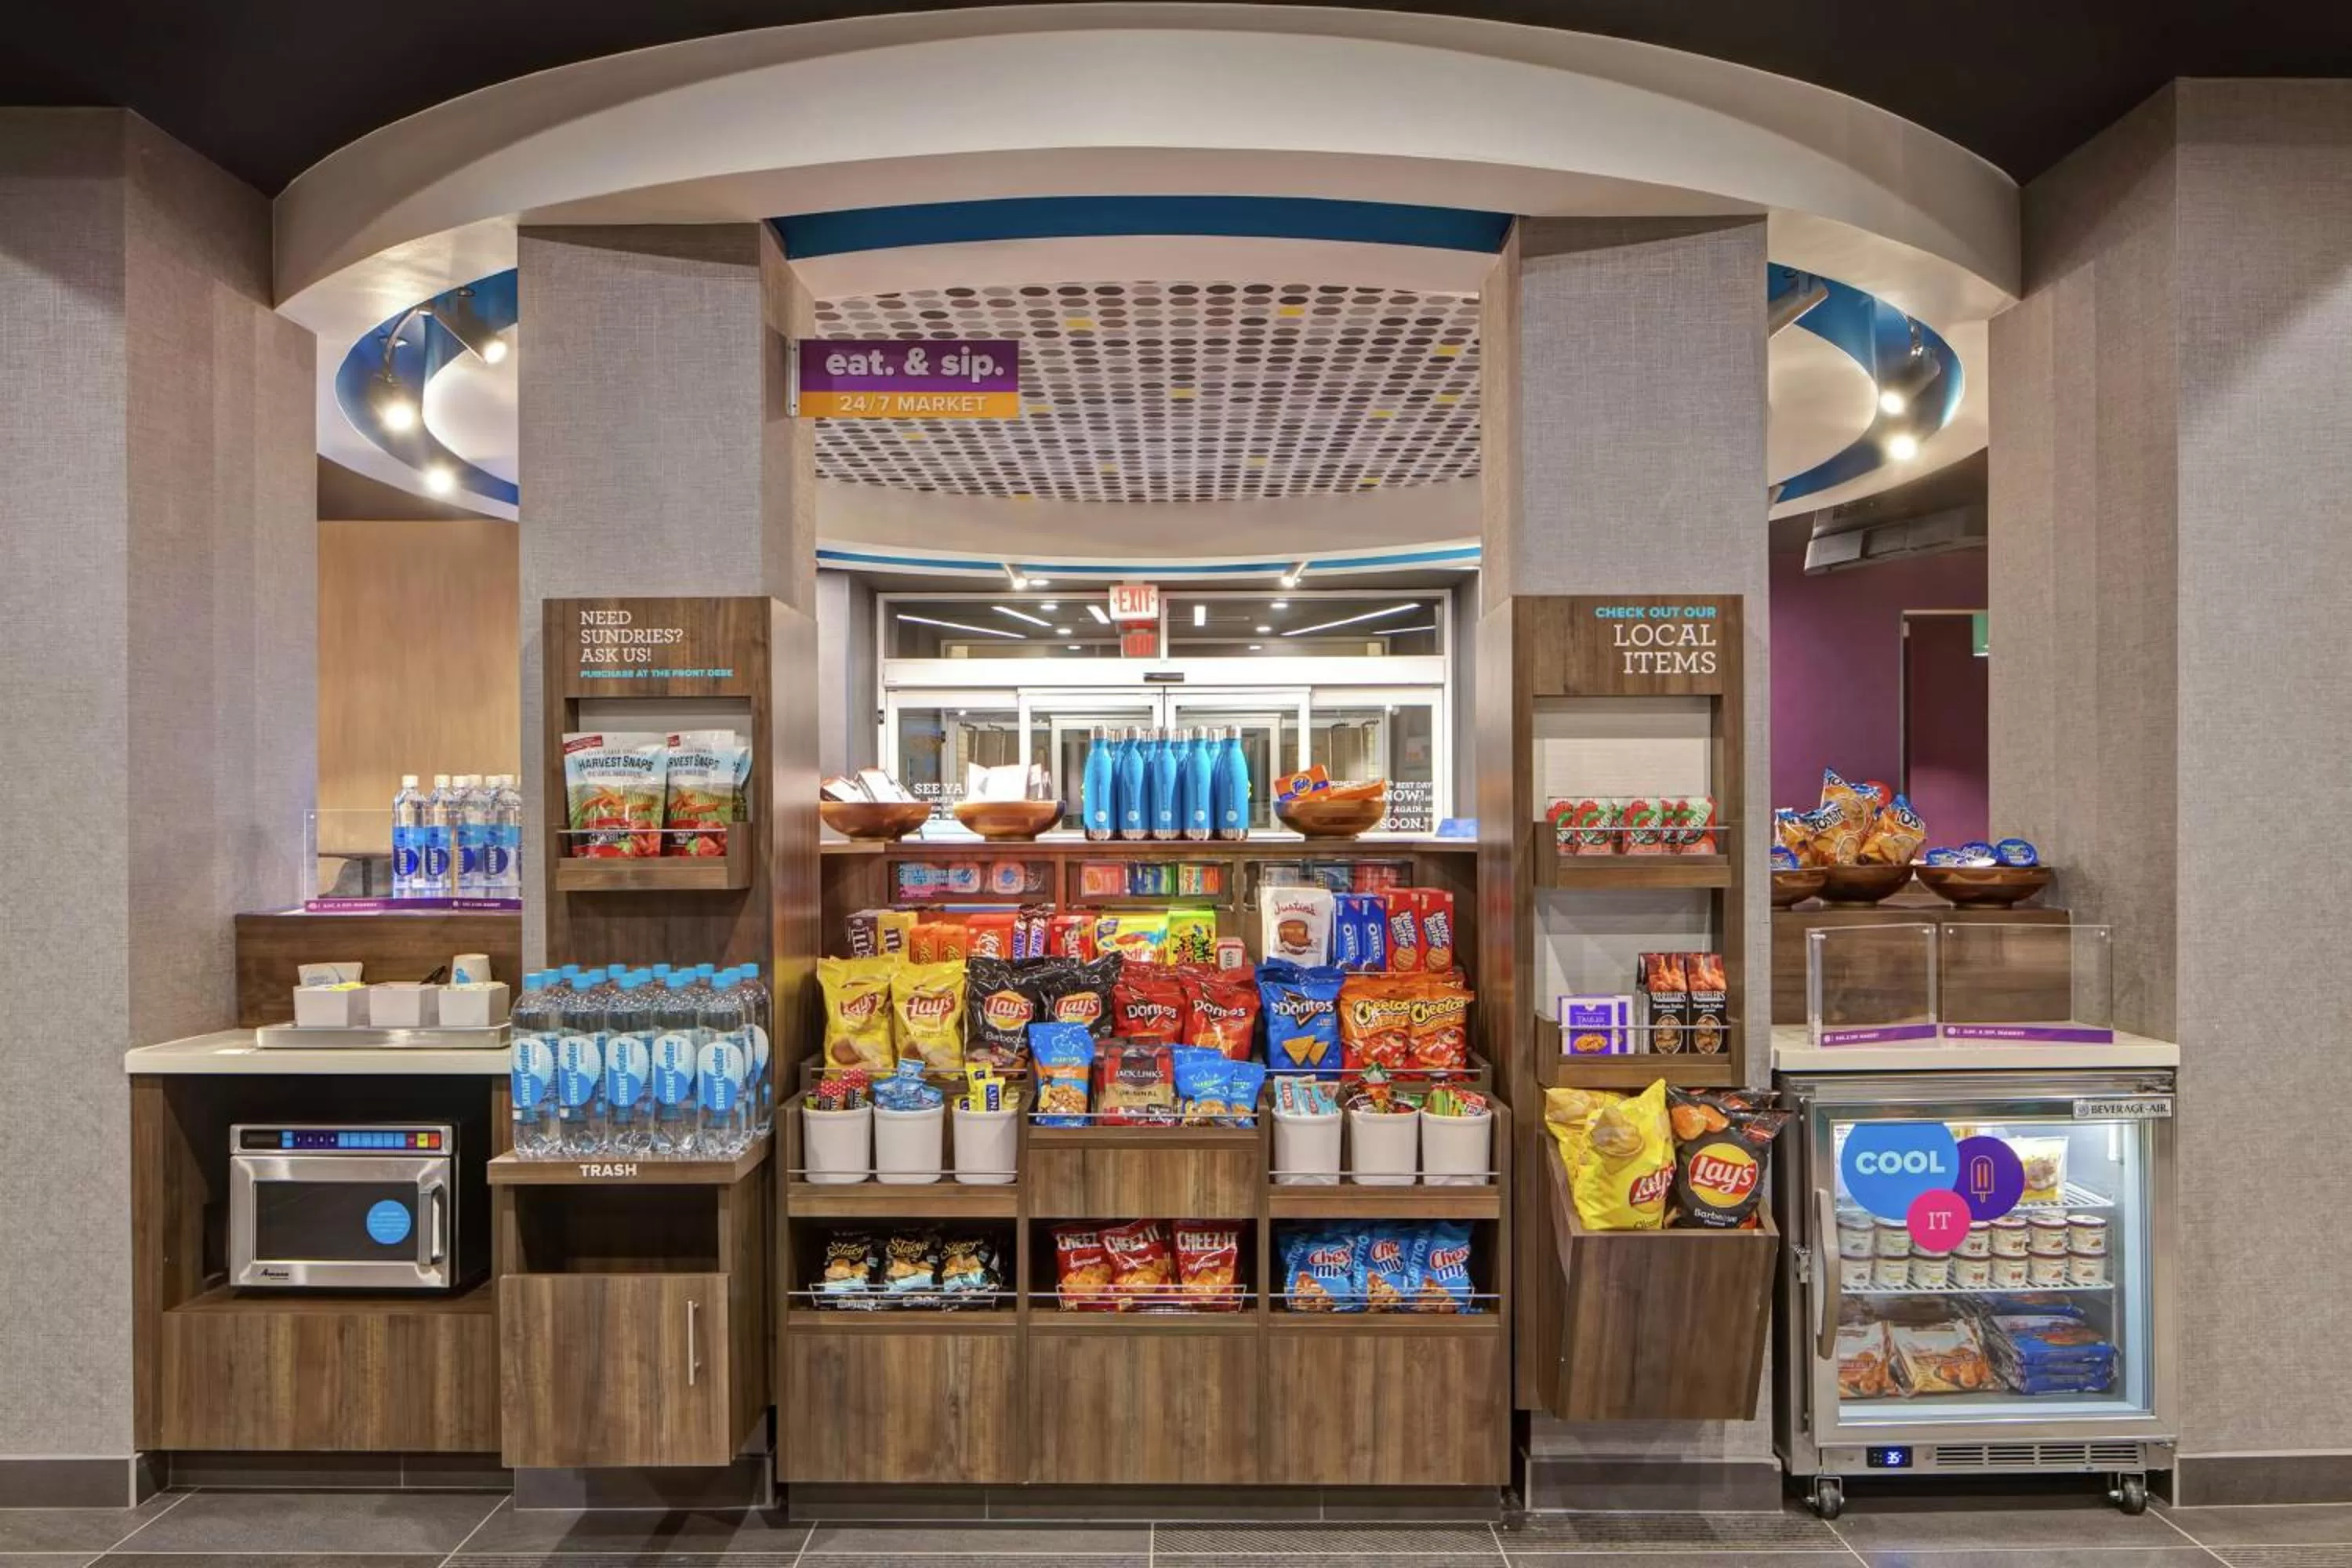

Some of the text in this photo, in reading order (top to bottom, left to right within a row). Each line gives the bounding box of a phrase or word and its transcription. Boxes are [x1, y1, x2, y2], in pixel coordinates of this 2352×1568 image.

[826, 346, 1005, 383] eat. & sip.
[840, 396, 987, 412] 24/7 MARKET
[1119, 587, 1154, 612] EXIT
[580, 611, 632, 625] NEED
[1595, 606, 1717, 618] CHECK OUT OUR
[580, 629, 684, 644] SUNDRIES?
[1613, 624, 1717, 647] LOCAL
[580, 648, 652, 662] ASK US!
[1623, 652, 1717, 674] ITEMS
[578, 755, 654, 771] HARVEST SNAPS
[667, 754, 694, 768] RVEST
[914, 783, 964, 794] SEE YA
[1382, 789, 1425, 802] NOW!
[1380, 818, 1425, 829] SOON.
[1279, 1000, 1334, 1016] Doritos
[989, 1086, 998, 1109] LUN
[580, 1164, 637, 1176] TRASH
[1856, 1150, 1946, 1175] COOL
[1693, 1156, 1755, 1194] Lay's
[1927, 1211, 1951, 1230] IT
